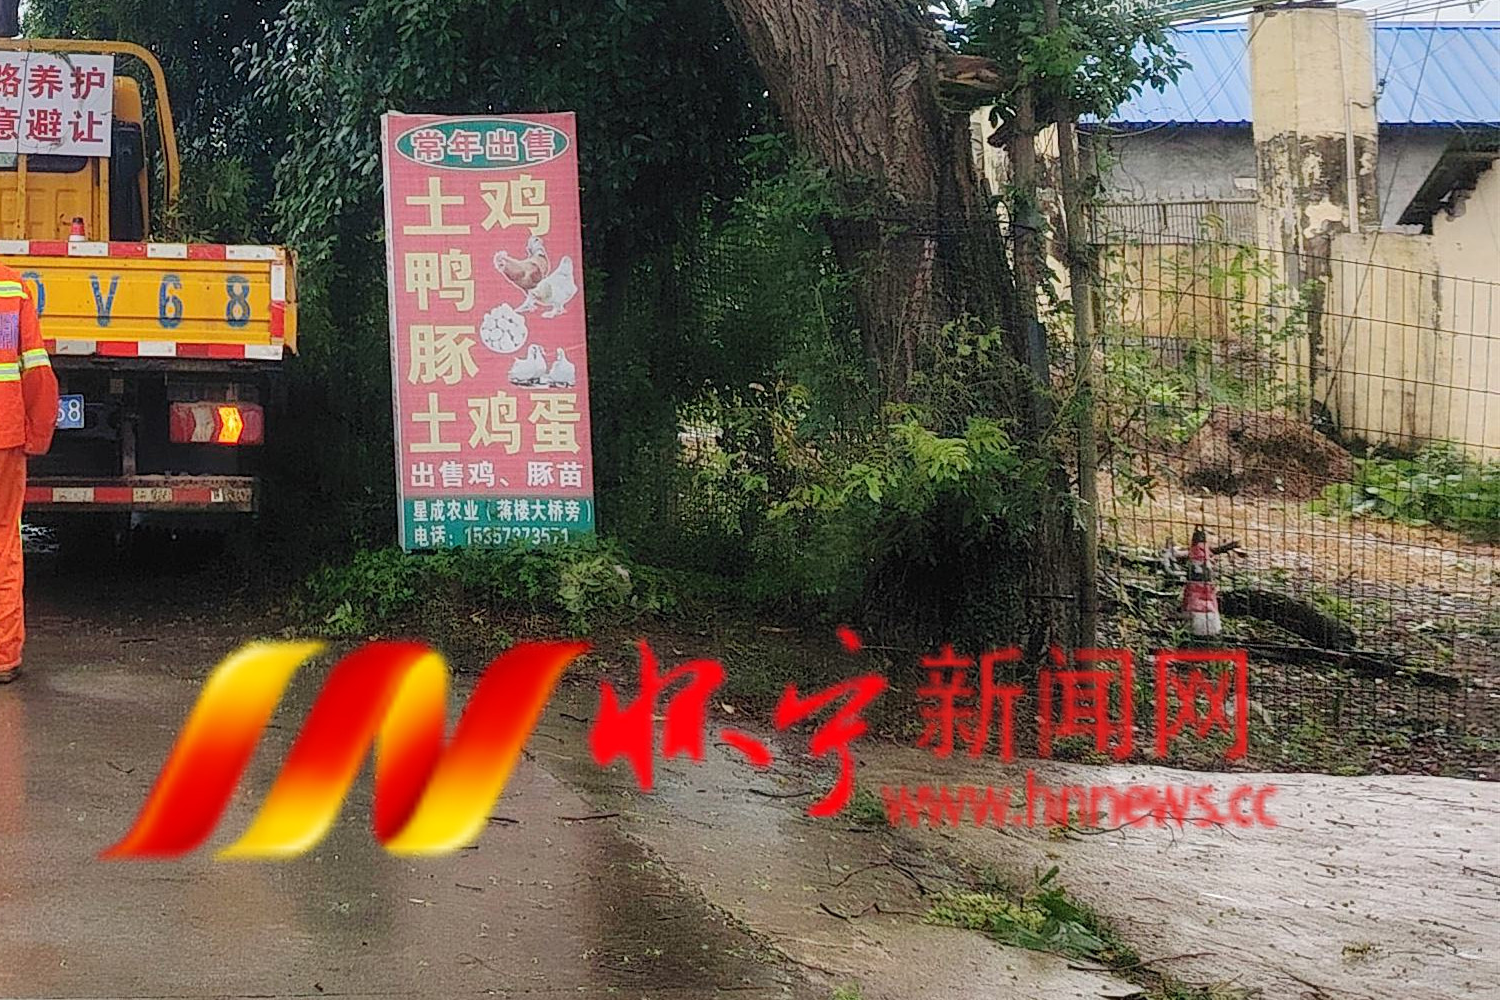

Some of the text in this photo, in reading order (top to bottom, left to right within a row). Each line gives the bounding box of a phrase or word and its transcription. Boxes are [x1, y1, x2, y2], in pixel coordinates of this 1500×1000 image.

[411, 127, 557, 163] 常年出售
[403, 174, 551, 236] 土鸡
[404, 248, 476, 312] 鸭
[407, 324, 480, 385] 豚
[409, 391, 582, 455] 土鸡蛋
[410, 461, 583, 488] 出售鸡、豚苗
